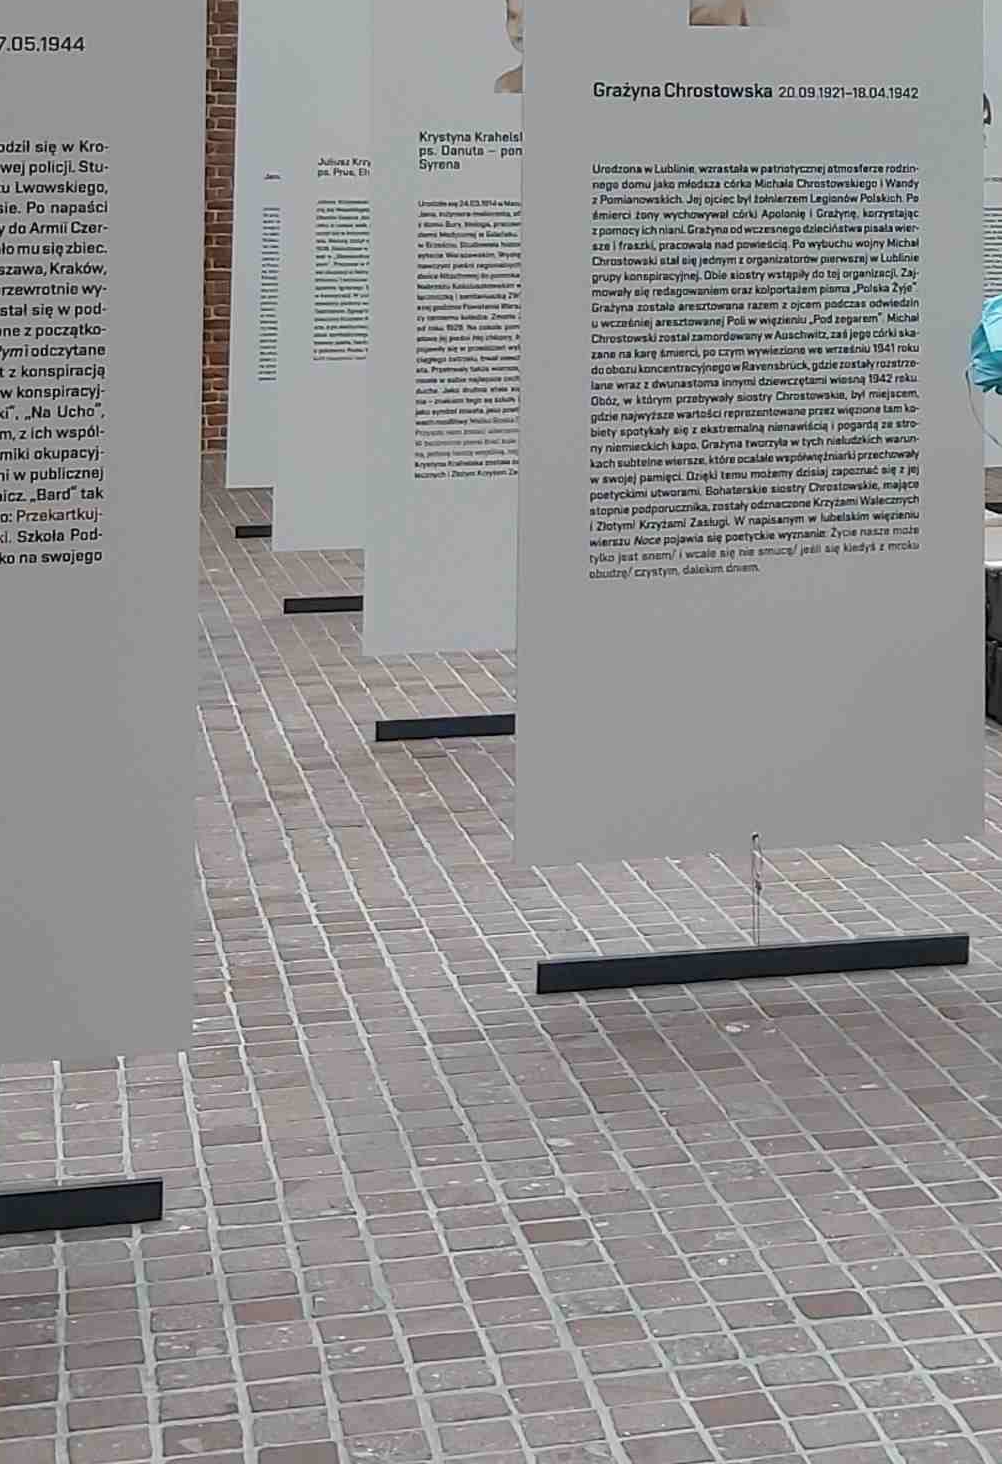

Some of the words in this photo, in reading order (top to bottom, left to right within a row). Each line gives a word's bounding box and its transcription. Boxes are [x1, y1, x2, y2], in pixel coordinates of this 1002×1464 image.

[593, 82, 661, 101] Grażyna
[664, 82, 773, 98] Chrostowska
[419, 132, 471, 144] Krystyna
[35, 140, 57, 156] się
[61, 143, 74, 152] w
[79, 139, 109, 153] Kro-
[441, 145, 484, 156] Danuta
[28, 159, 76, 176] policji.
[77, 159, 109, 173] Stu-
[419, 159, 460, 171] Syrena
[14, 180, 108, 196] Lwowskiego,
[26, 200, 45, 214] Po
[50, 200, 108, 217] napaści
[8, 221, 26, 235] do
[28, 221, 68, 234] Armii
[70, 221, 108, 234] Czer-
[49, 261, 107, 276] Kraków,
[81, 284, 107, 298] wy-
[8, 368, 16, 378] z
[20, 363, 105, 381] konspiracją
[0, 389, 13, 399] w
[16, 383, 105, 401] konspiracyj-
[33, 445, 104, 463] okupacyj-
[16, 528, 65, 543] Szkoła
[70, 526, 102, 541] Pod-
[19, 553, 37, 564] na
[41, 549, 102, 565] swojego
